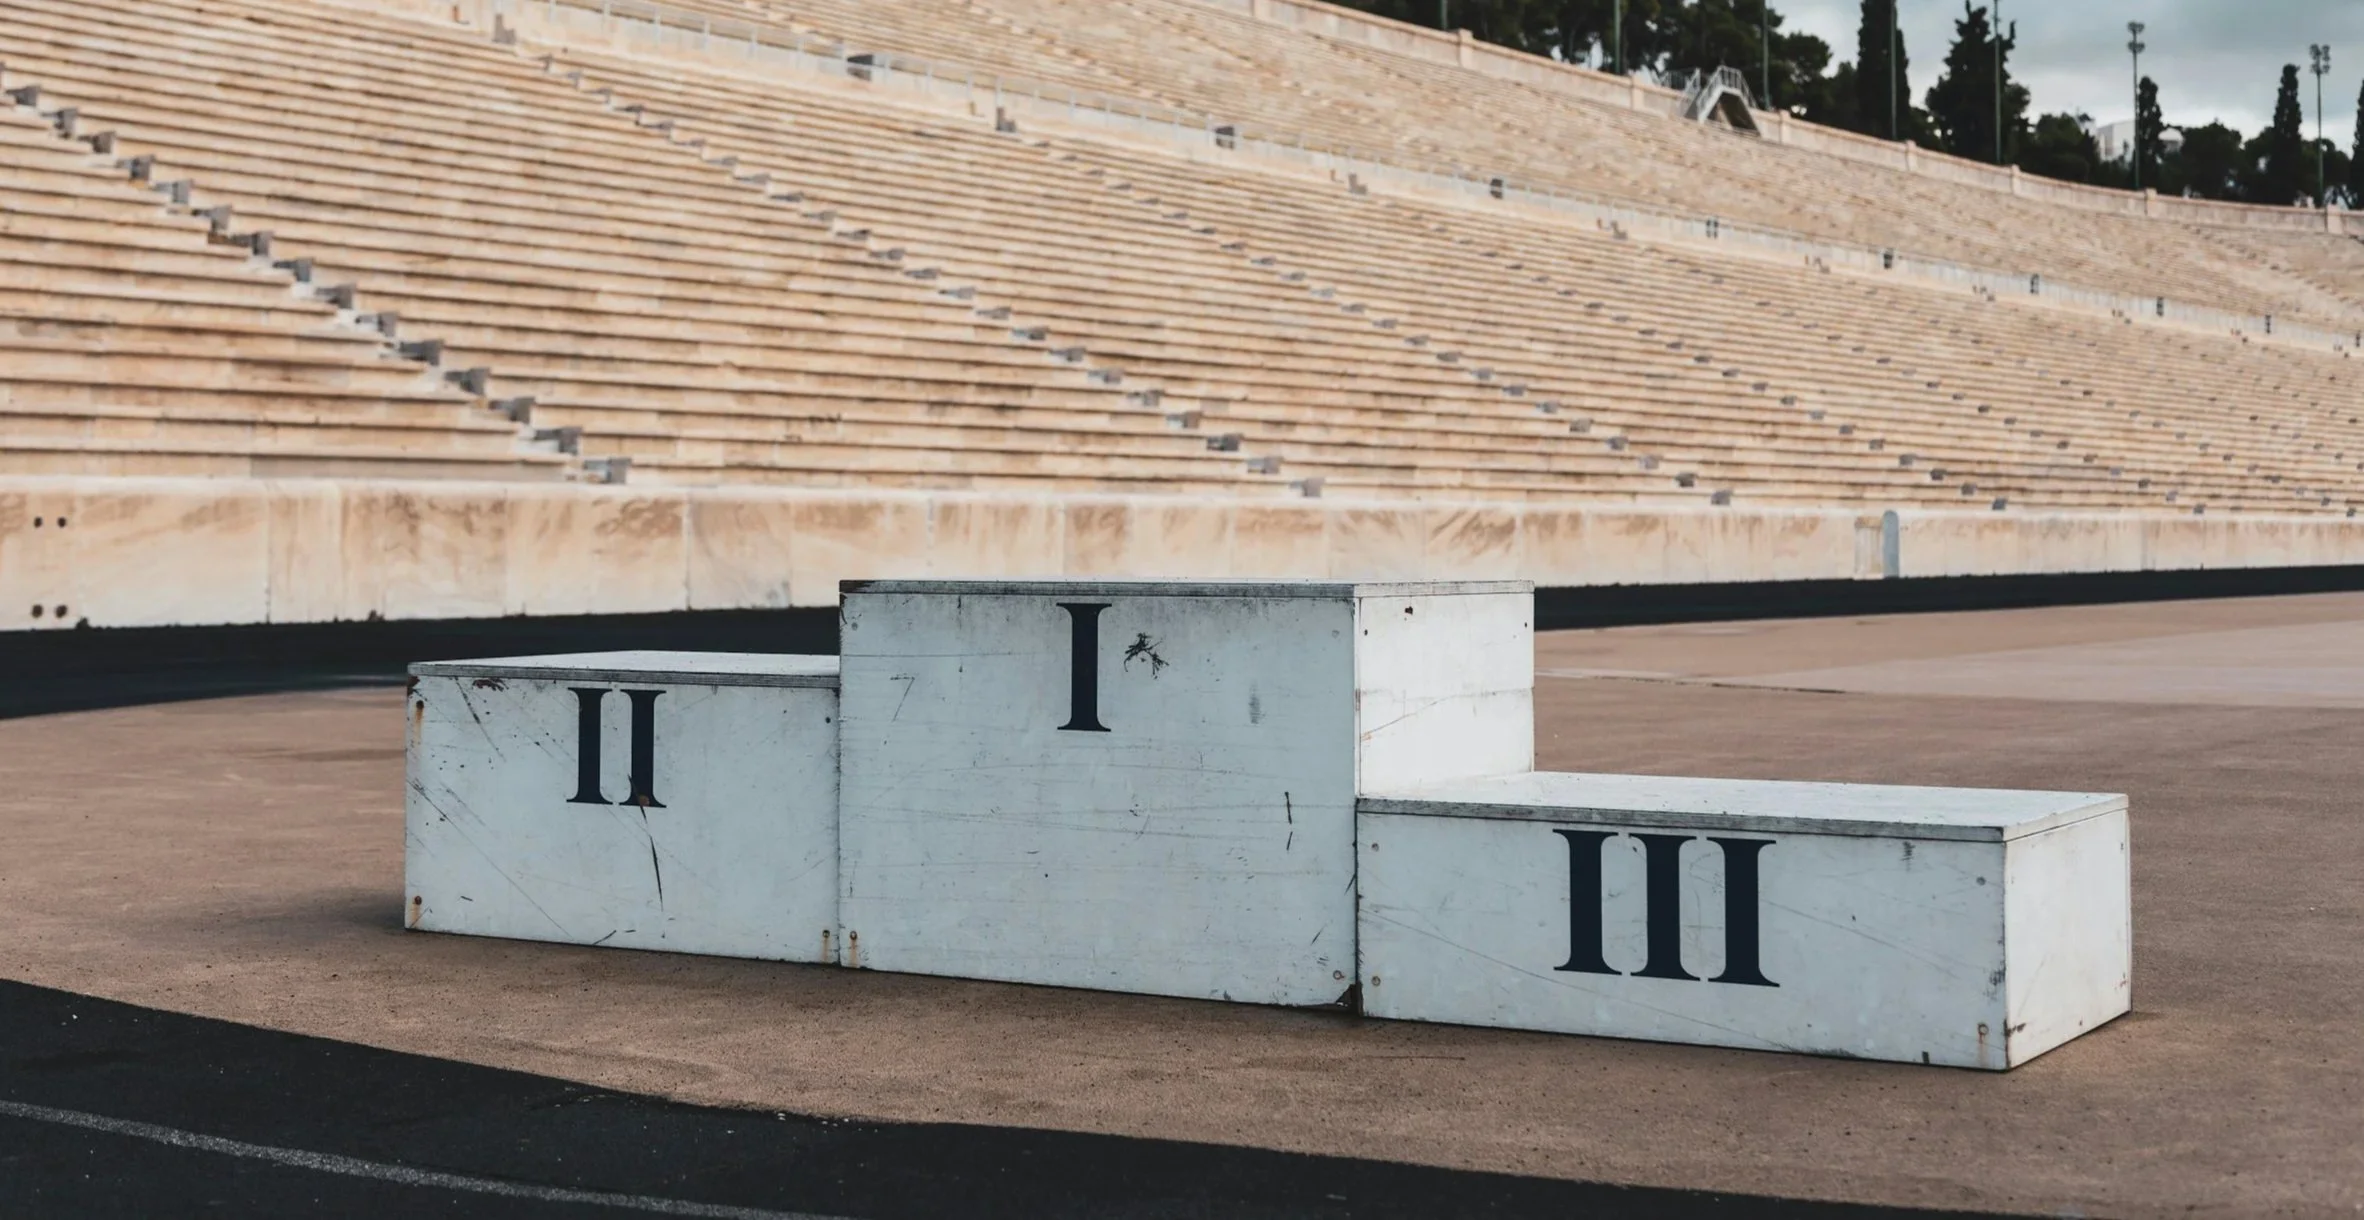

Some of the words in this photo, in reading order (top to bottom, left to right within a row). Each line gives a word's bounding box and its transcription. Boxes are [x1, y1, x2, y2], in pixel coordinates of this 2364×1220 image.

[1056, 602, 1112, 733] I
[566, 687, 667, 808] II
[1552, 828, 1780, 988] III
